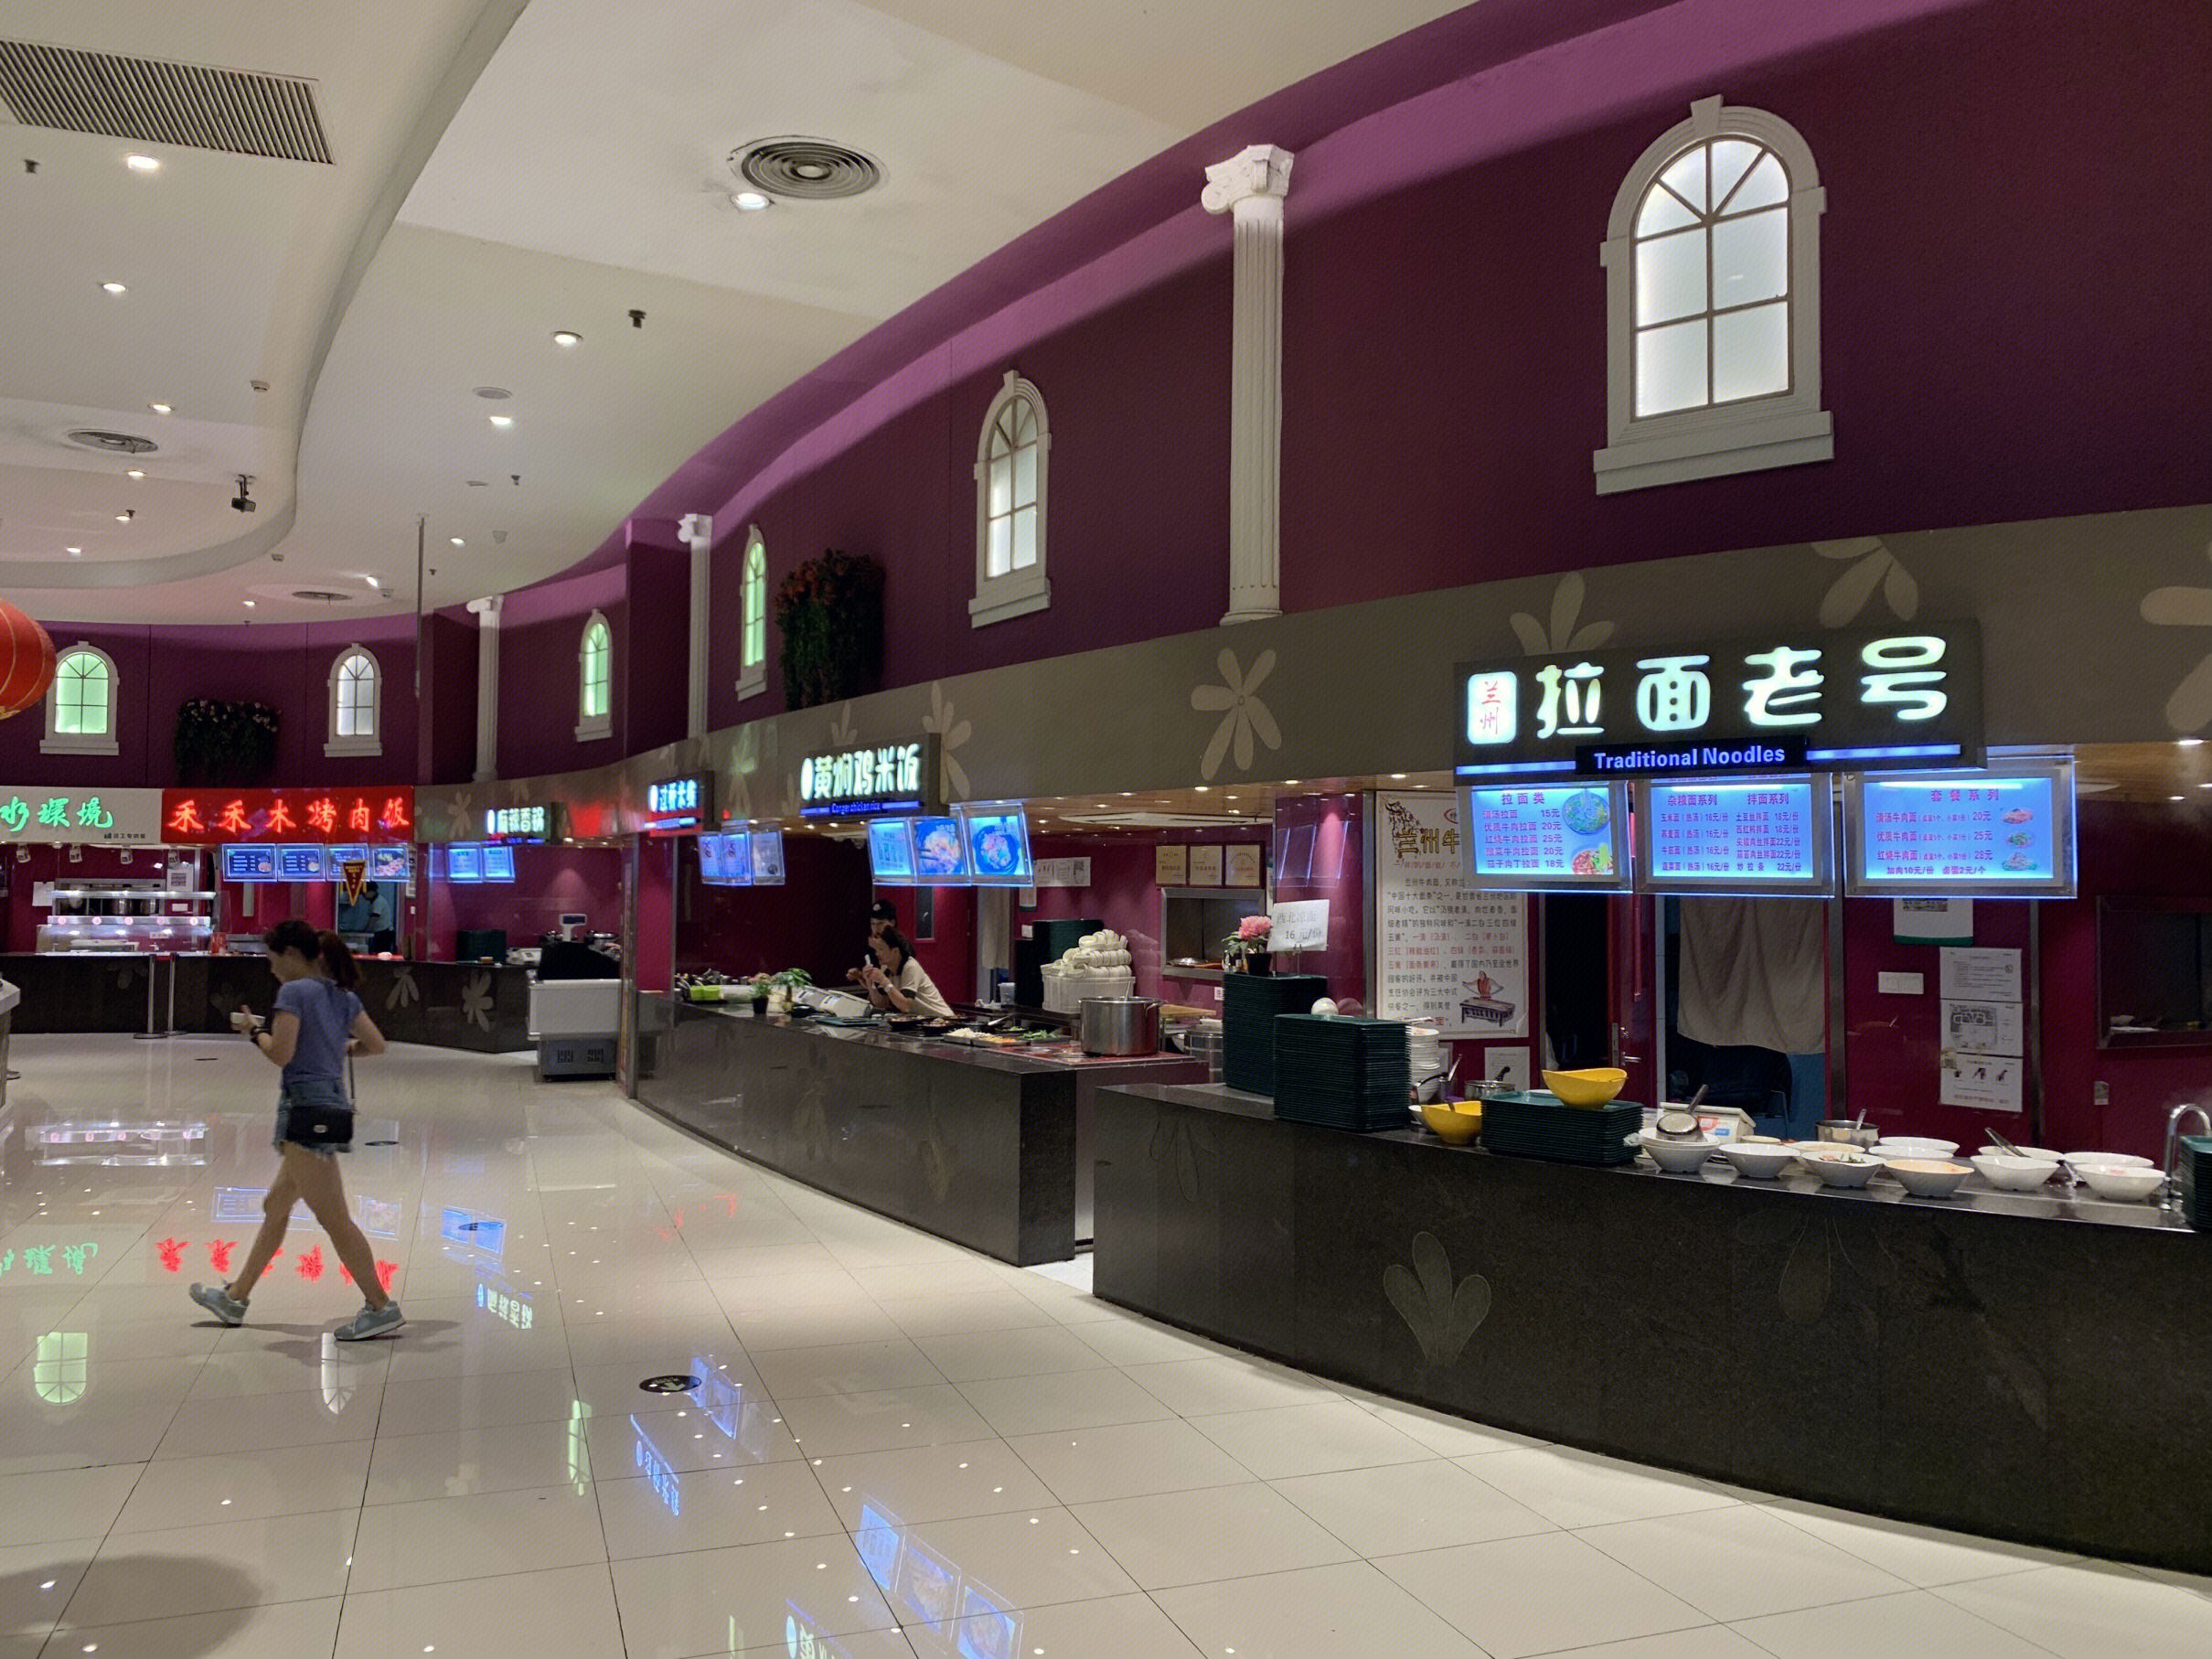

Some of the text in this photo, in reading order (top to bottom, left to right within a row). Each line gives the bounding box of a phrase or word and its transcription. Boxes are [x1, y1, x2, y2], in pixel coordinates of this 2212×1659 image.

[1536, 636, 1948, 739] 拉面老号
[1480, 680, 1501, 735] 兰州
[1594, 745, 1786, 769] Traditional Noodles
[814, 744, 920, 799] 黄焖鸡米饭
[1501, 792, 1544, 805] 拉面类
[1668, 794, 1717, 806] 杂粮面系列
[1747, 793, 1790, 805] 拌面系列
[1931, 789, 1999, 801] 套餐系列
[1541, 809, 1560, 818] 15元
[1543, 835, 1563, 843] 25元
[1544, 847, 1564, 855] 20元
